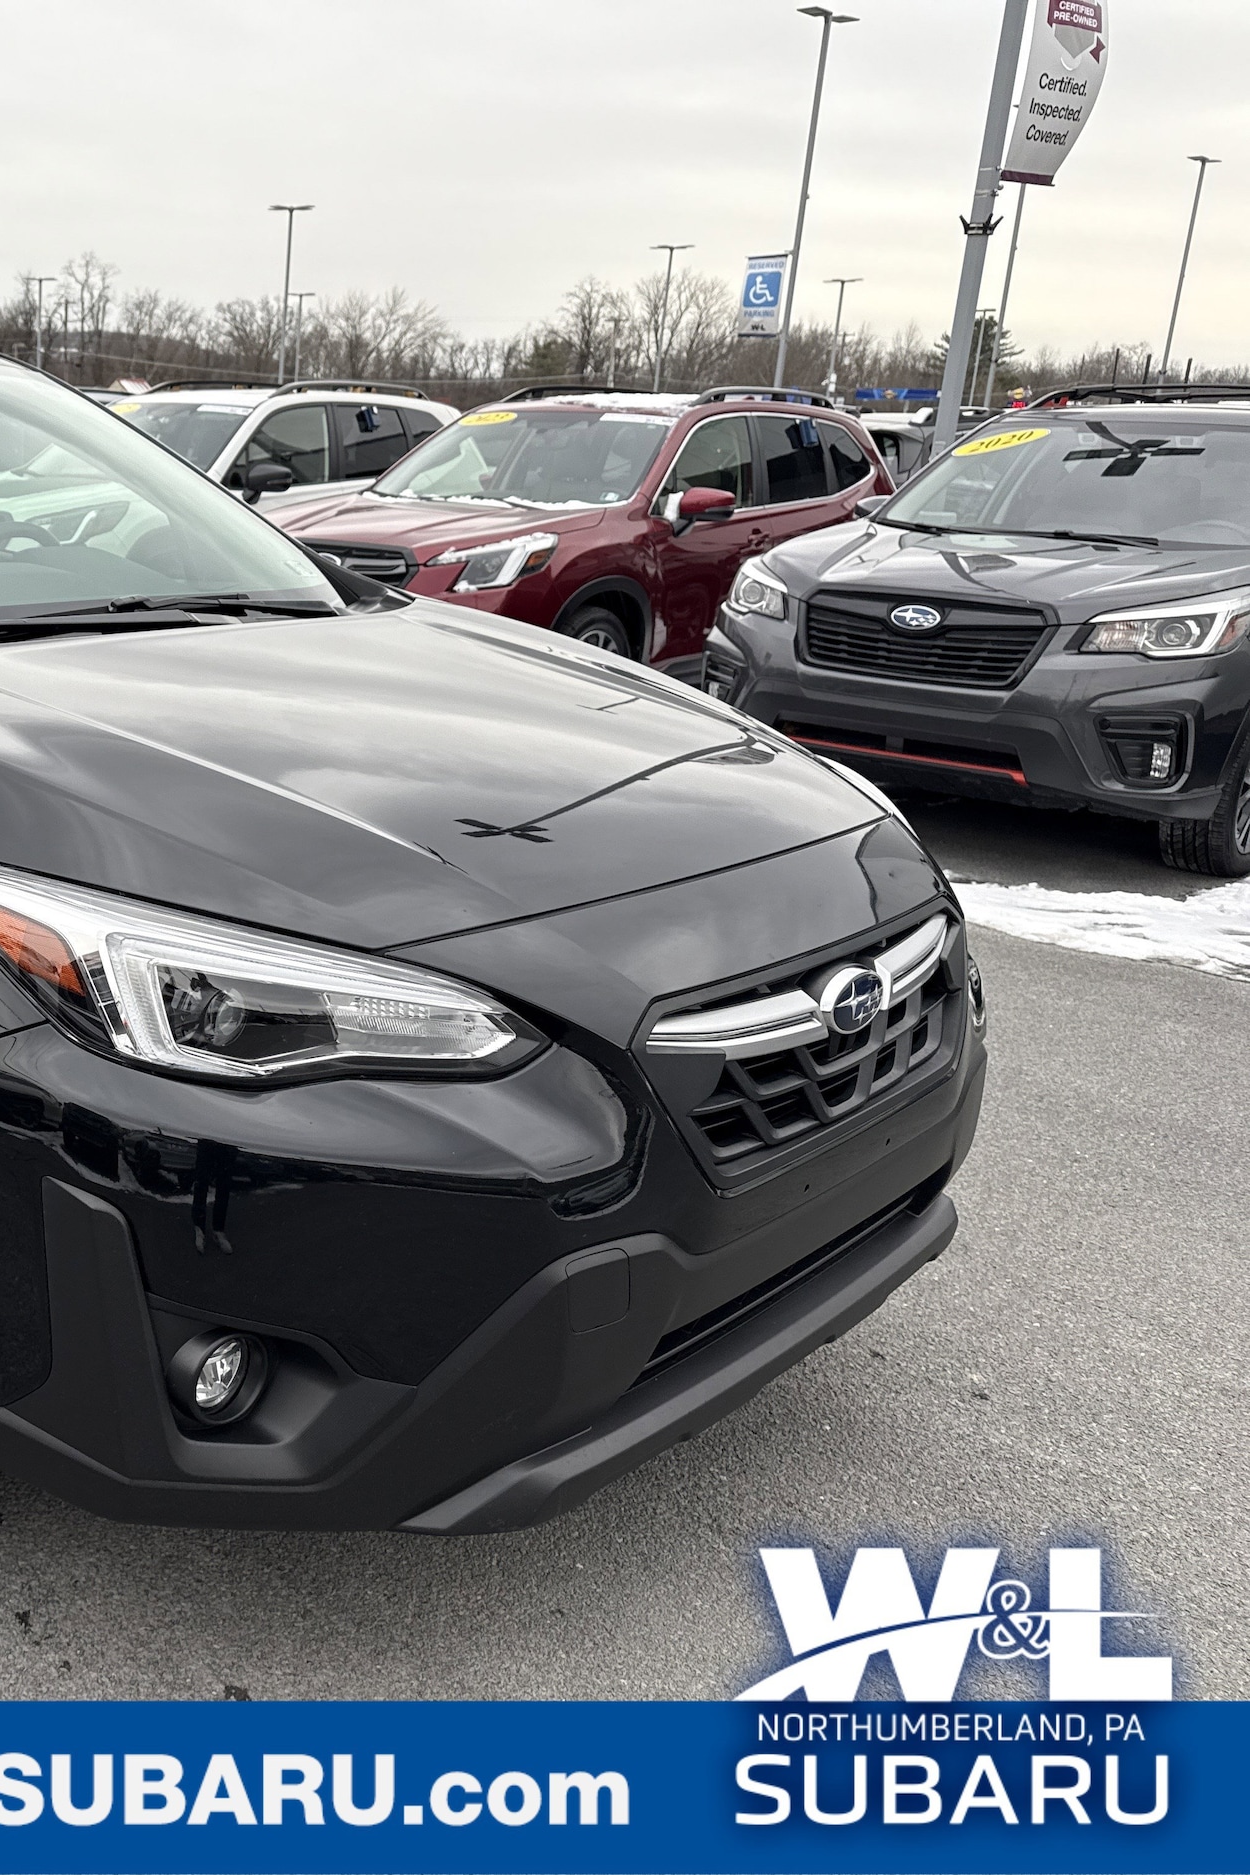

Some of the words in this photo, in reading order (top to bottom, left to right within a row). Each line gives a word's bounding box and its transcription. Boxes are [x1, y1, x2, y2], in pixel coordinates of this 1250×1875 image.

[1053, 11, 1098, 28] PRE-OWNED
[1059, 0, 1095, 17] CERTIFIED
[1039, 72, 1087, 97] Certified.
[1029, 98, 1082, 122] Inspected.
[1026, 124, 1068, 146] Covered.
[748, 261, 784, 270] RESERVED
[968, 431, 1034, 453] 2020
